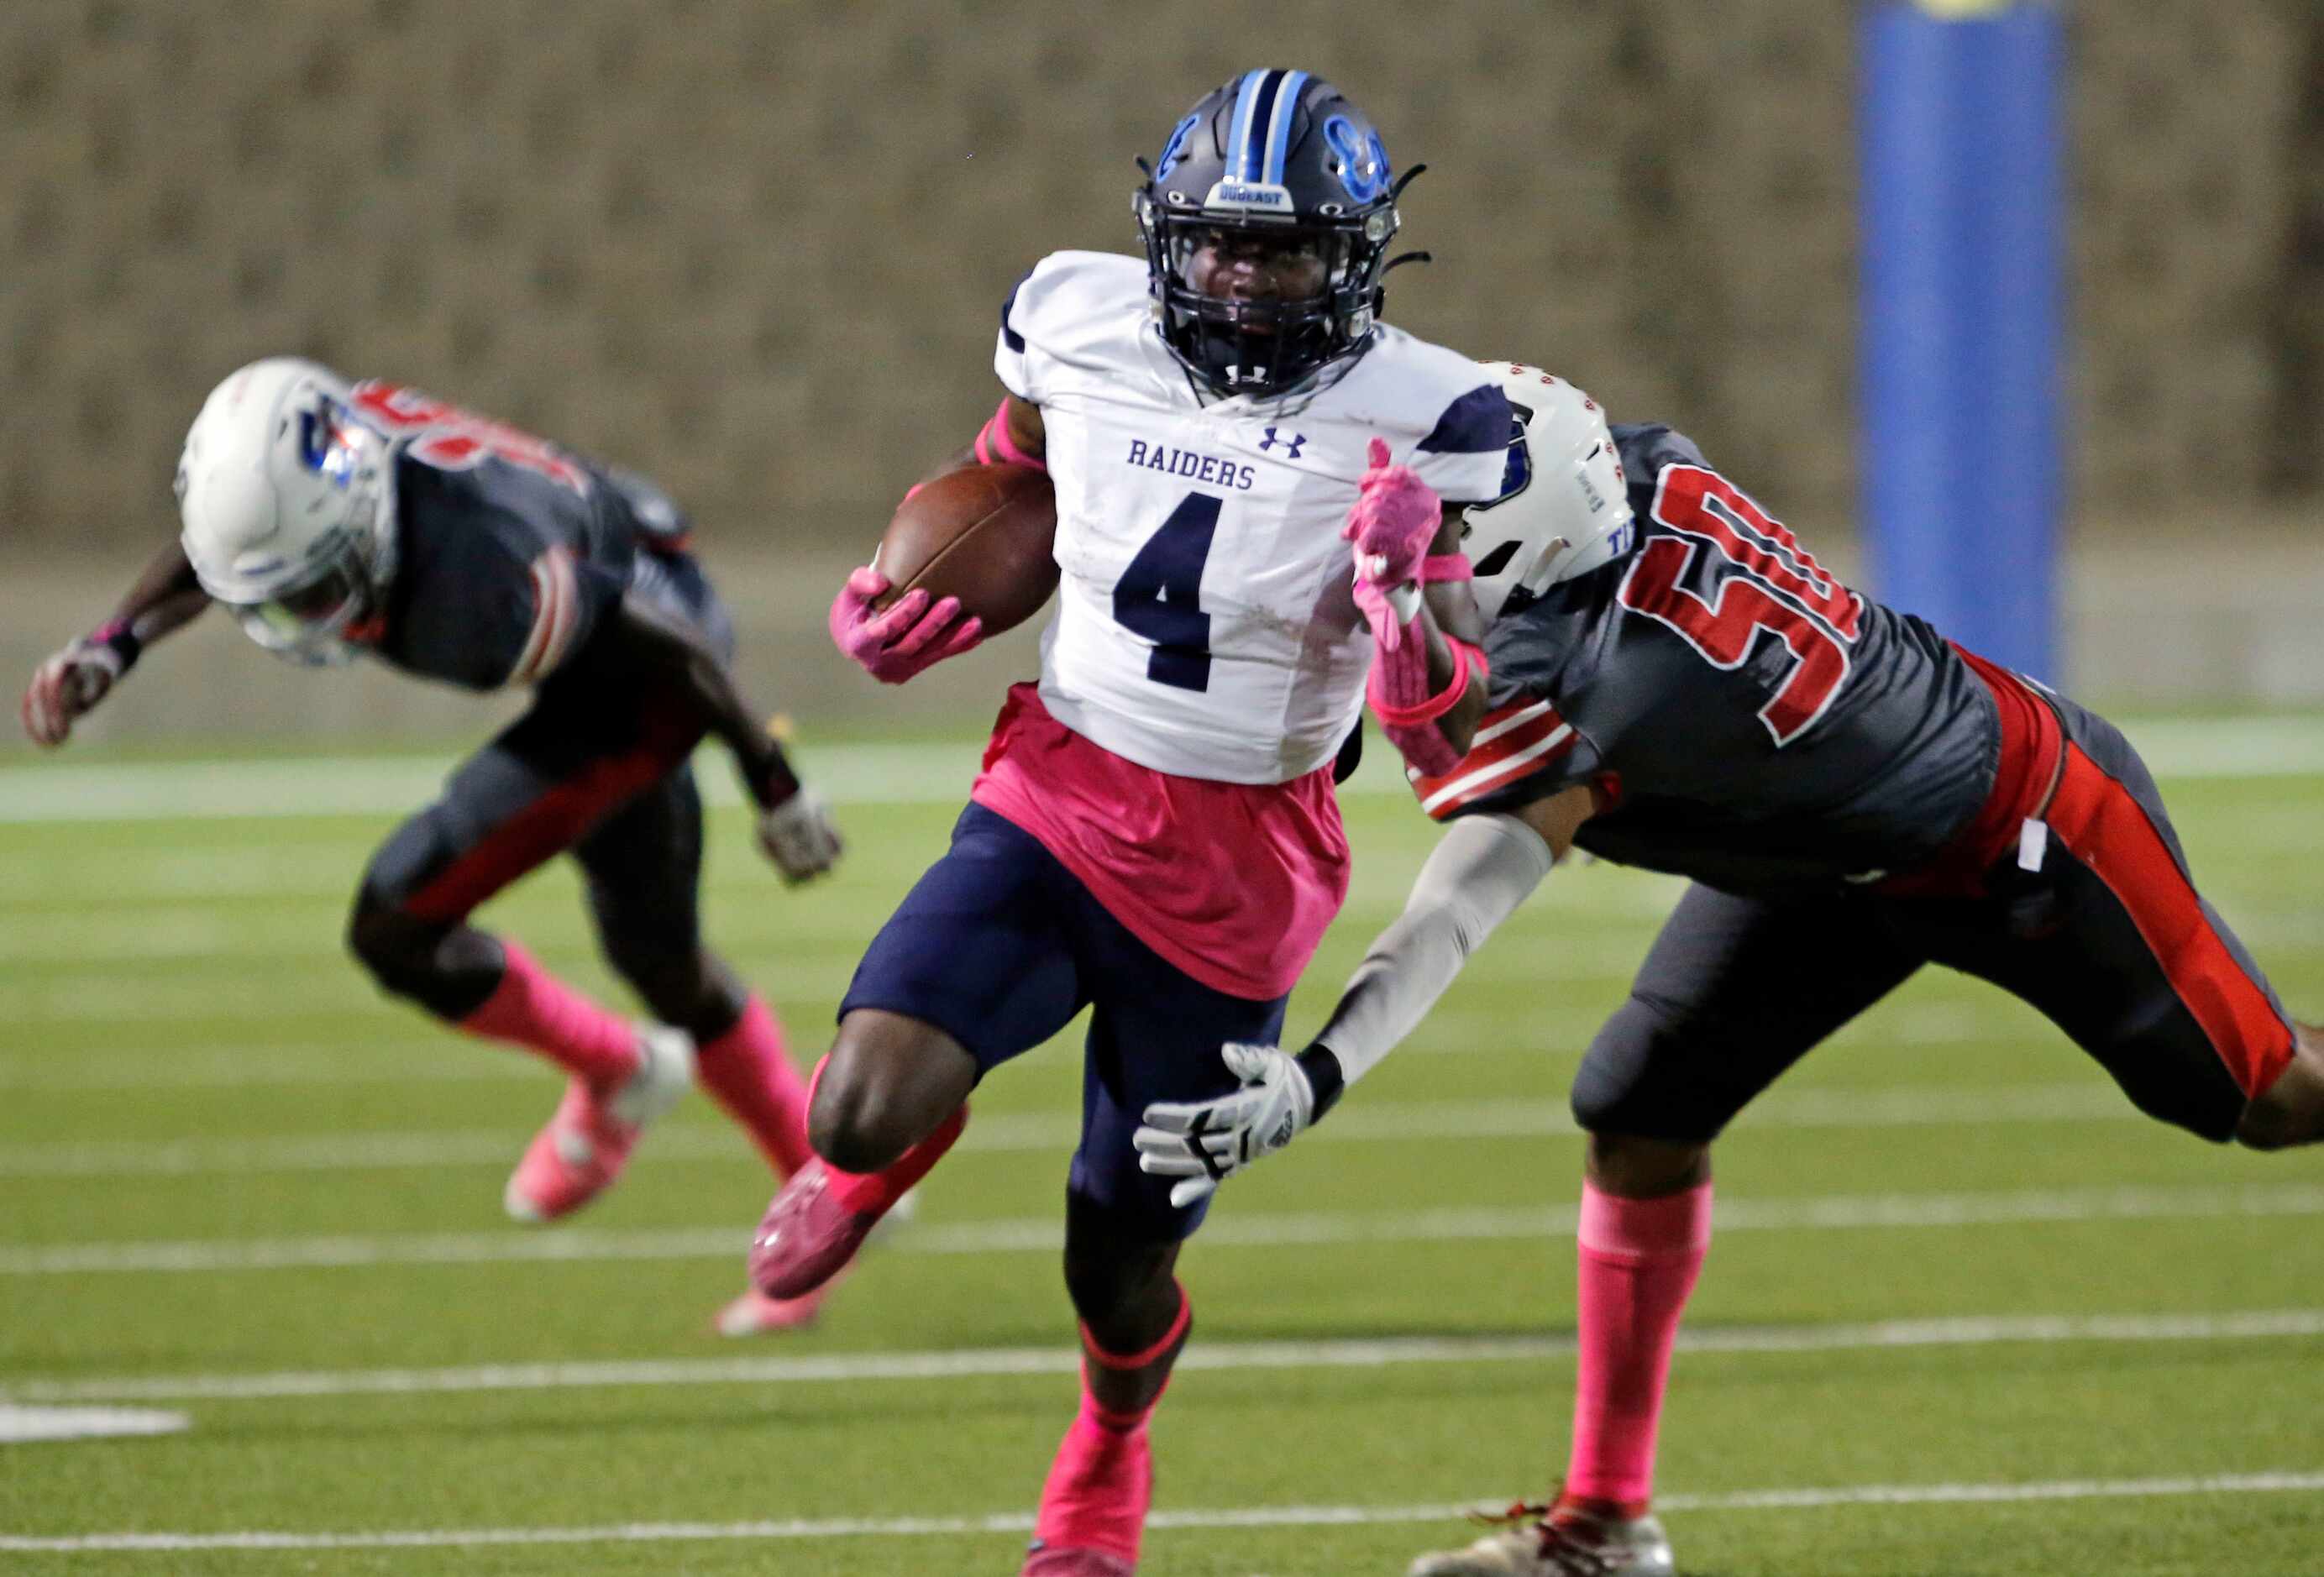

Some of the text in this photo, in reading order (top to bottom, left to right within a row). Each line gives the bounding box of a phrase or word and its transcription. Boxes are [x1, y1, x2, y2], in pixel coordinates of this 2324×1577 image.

[1126, 438, 1256, 490] RAIDERS
[1112, 491, 1224, 693] 4
[1616, 463, 1865, 749] 50
